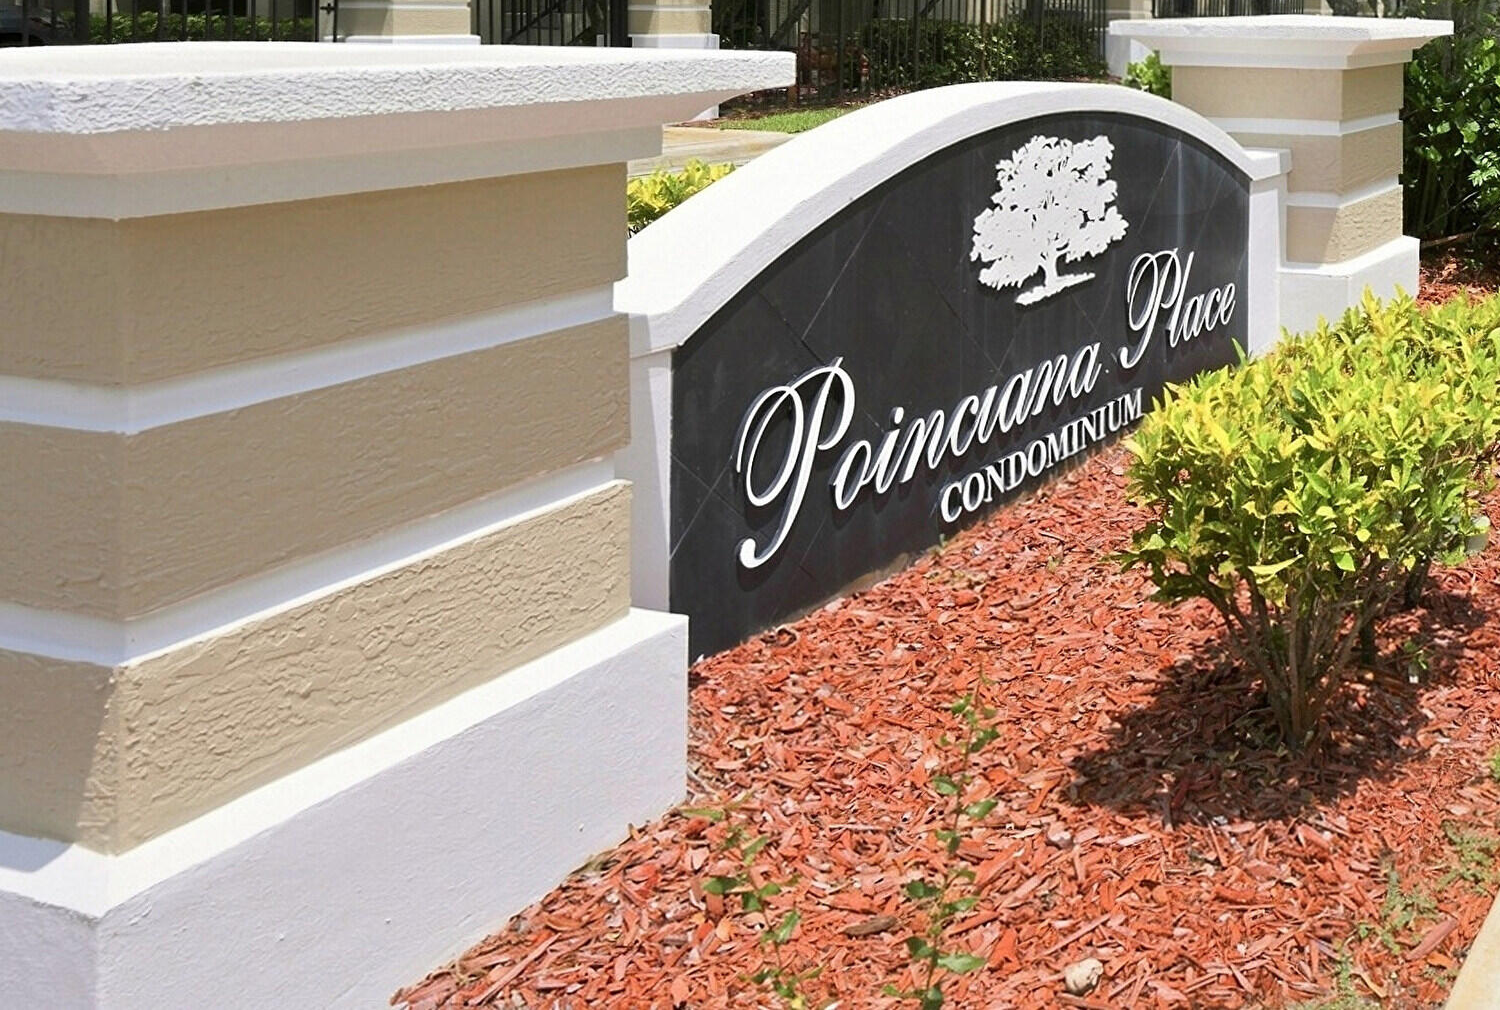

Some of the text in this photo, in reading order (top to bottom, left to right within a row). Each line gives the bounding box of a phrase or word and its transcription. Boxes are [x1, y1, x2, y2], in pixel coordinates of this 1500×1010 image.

[737, 248, 1236, 569] Poinciana Place
[940, 387, 1144, 523] CONDOMINIUM
